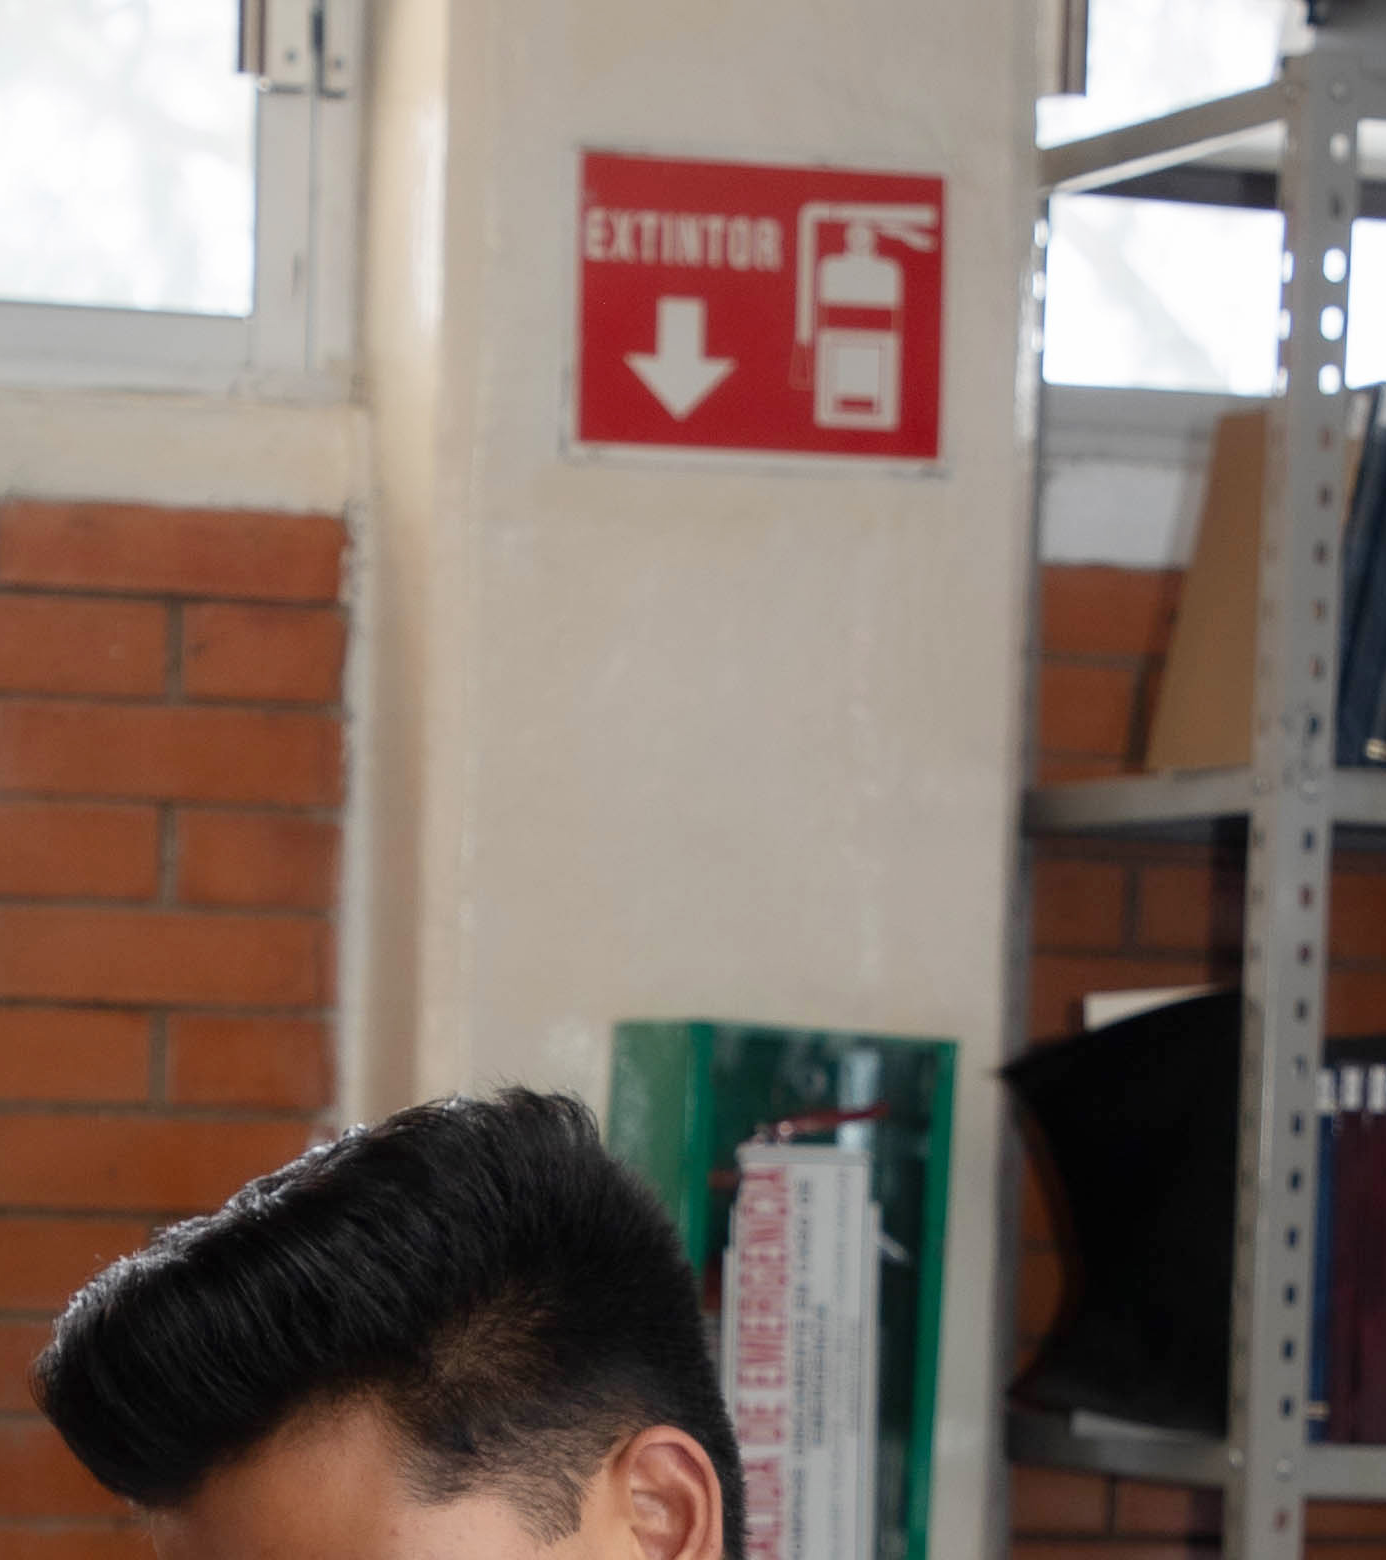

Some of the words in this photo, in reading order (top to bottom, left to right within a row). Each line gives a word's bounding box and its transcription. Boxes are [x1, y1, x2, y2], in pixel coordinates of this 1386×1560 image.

[584, 206, 784, 272] EXTINTOR
[737, 1166, 789, 1390] EMERGENCIA
[738, 1400, 784, 1446] DE
